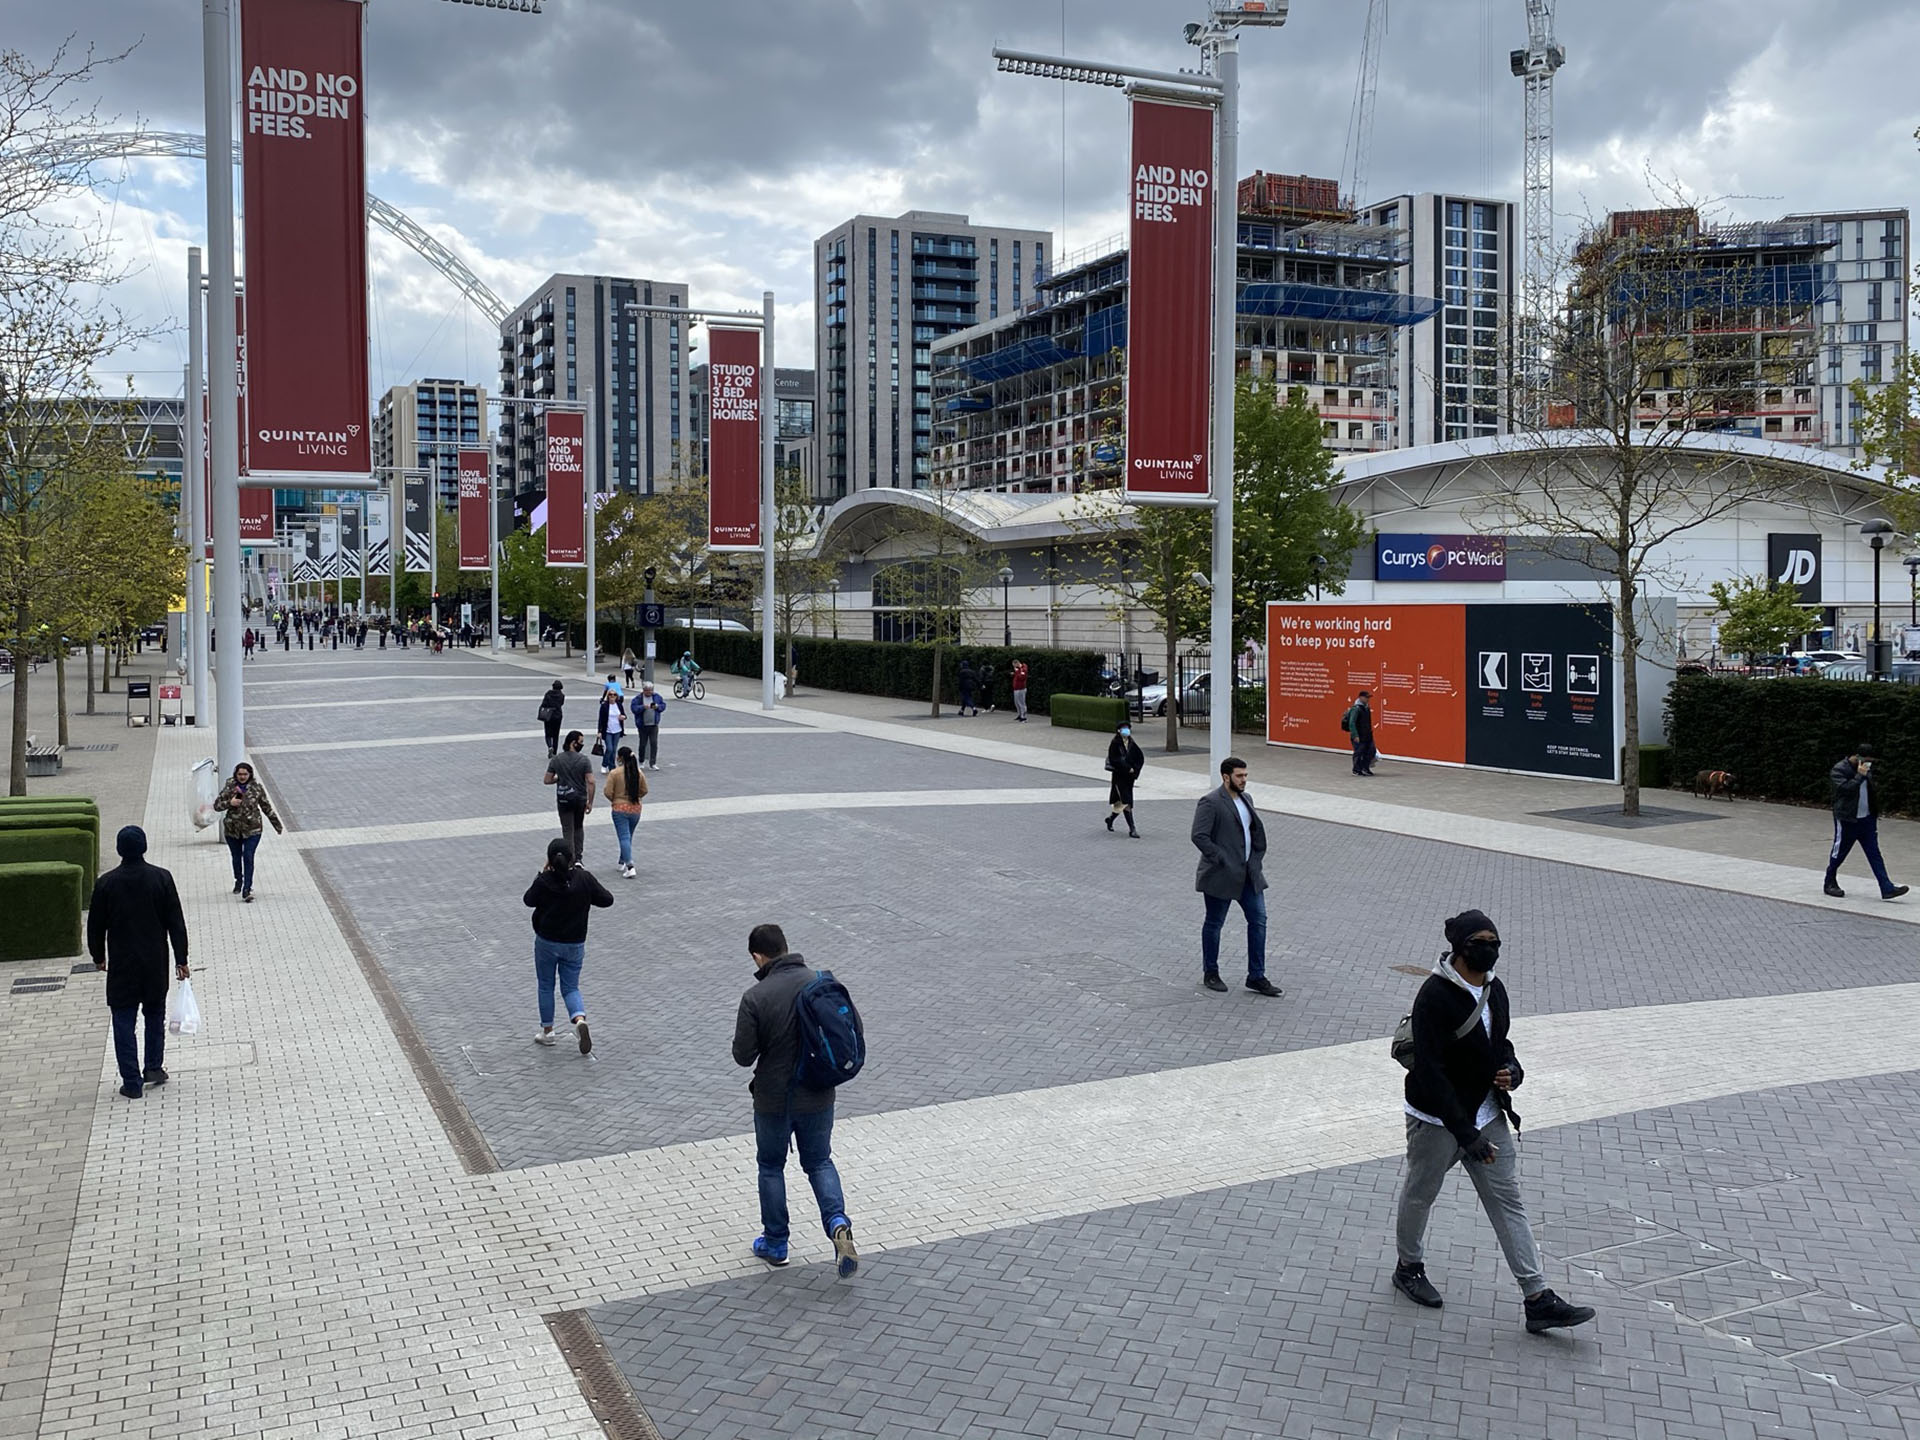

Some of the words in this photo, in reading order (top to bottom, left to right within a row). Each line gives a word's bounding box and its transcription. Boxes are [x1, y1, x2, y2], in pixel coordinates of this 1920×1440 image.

[248, 66, 308, 92] AND
[316, 72, 357, 97] NO
[249, 89, 348, 119] HIDDEN
[249, 112, 312, 139] FEES.
[1136, 164, 1175, 185] AND
[1180, 168, 1208, 188] NO
[1136, 183, 1202, 207] HIDDEN
[1136, 202, 1177, 223] FEES.
[712, 363, 755, 377] STUDIO
[712, 375, 721, 388] 1,
[724, 375, 735, 387] 2
[735, 376, 753, 388] OR
[774, 377, 800, 388] Centre
[712, 386, 721, 397] 3
[723, 387, 745, 399] BED
[712, 397, 758, 410] STYLISH
[712, 408, 758, 421] HOMES.
[258, 429, 347, 443] QUINTAIN
[548, 436, 571, 446] POP
[571, 437, 583, 446] IN
[298, 443, 348, 456] LIVING
[548, 445, 572, 455] AND
[548, 453, 575, 464] VIEW
[1134, 459, 1194, 470] QUINTAIN
[460, 469, 480, 477] LOVE
[548, 462, 583, 473] TODAY.
[460, 477, 488, 485] WHERE
[1160, 470, 1194, 480] LIVING
[461, 490, 483, 498] RENT.
[1382, 549, 1426, 568] Currys
[1447, 550, 1466, 566] PC
[1467, 550, 1504, 566] World
[1778, 549, 1816, 585] JD
[1280, 616, 1312, 630] We're
[1314, 616, 1361, 633] working
[1363, 617, 1392, 631] hard
[1280, 634, 1293, 646] to
[1295, 633, 1322, 650] keep
[1325, 637, 1346, 650] you
[1348, 635, 1376, 649] safe
